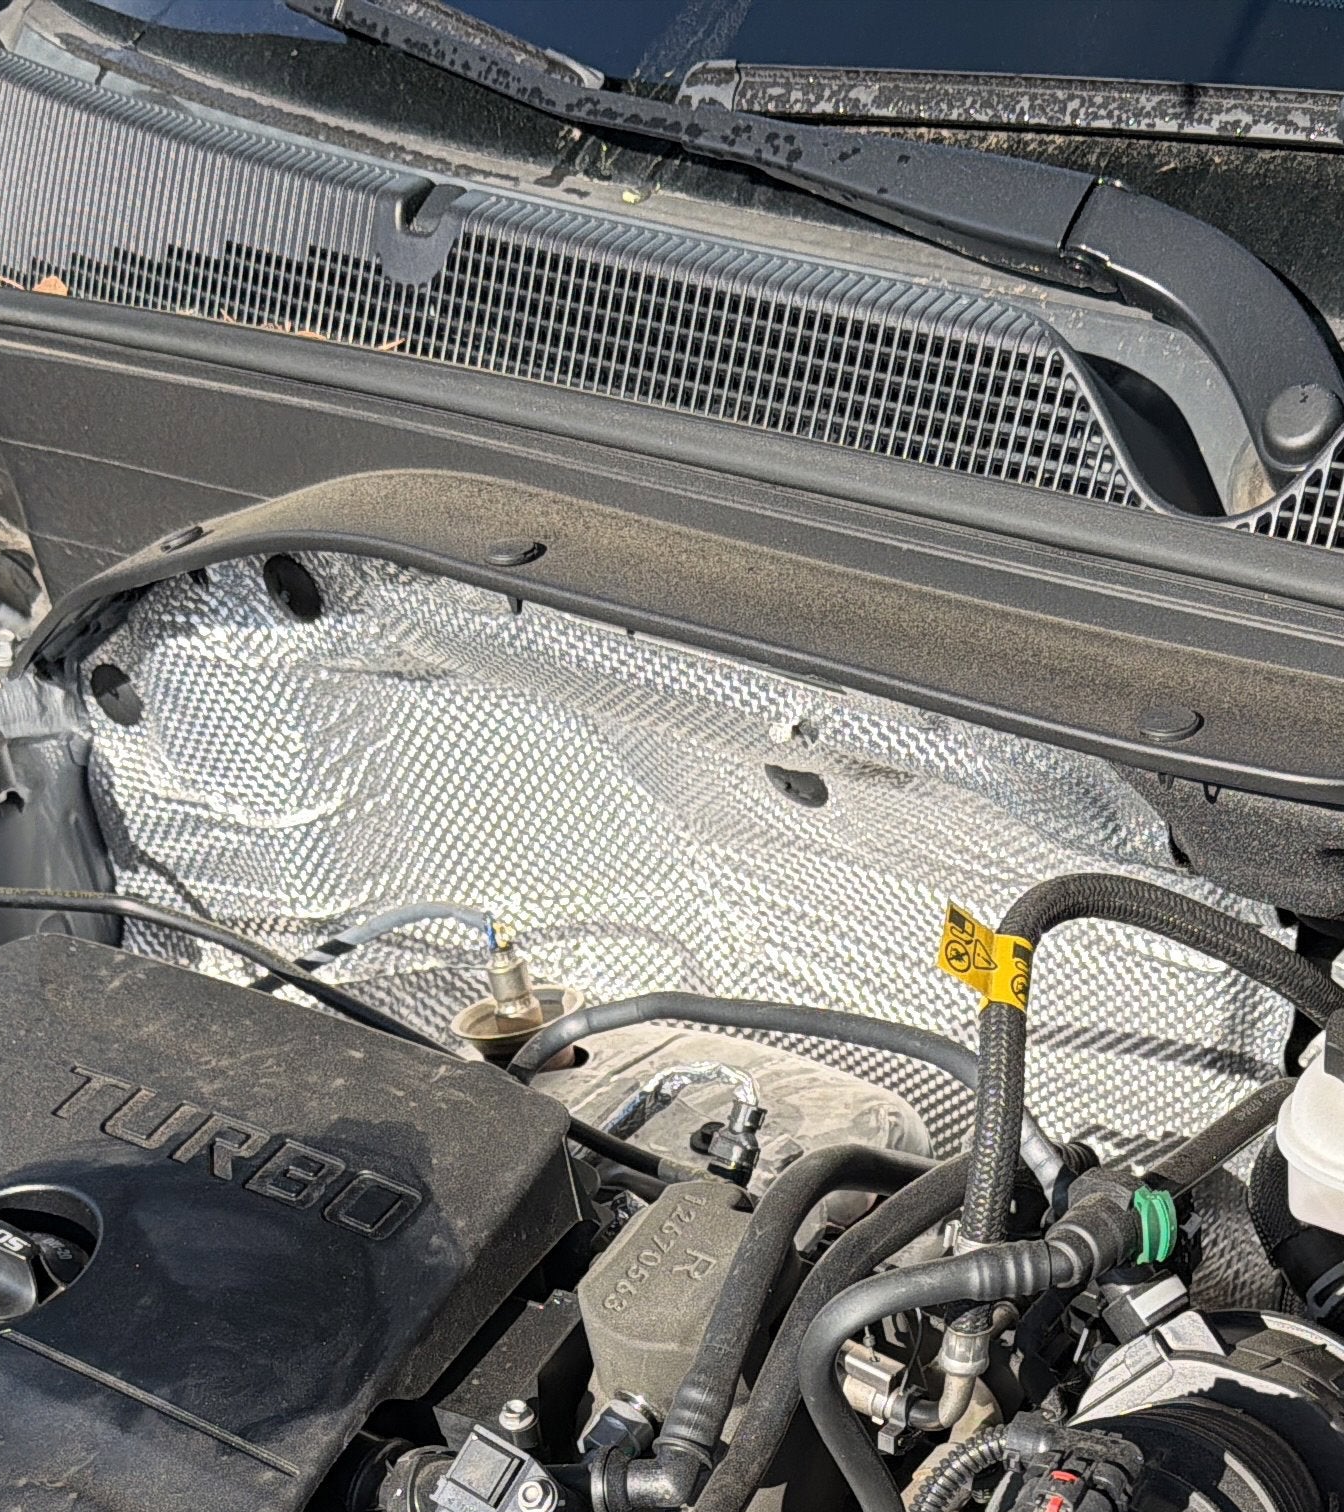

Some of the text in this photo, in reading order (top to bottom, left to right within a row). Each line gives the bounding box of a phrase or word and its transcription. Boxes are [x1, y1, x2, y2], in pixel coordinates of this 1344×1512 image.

[51, 1064, 423, 1240] TURBO
[602, 1189, 713, 1314] 12670563
[685, 1251, 720, 1283] R
